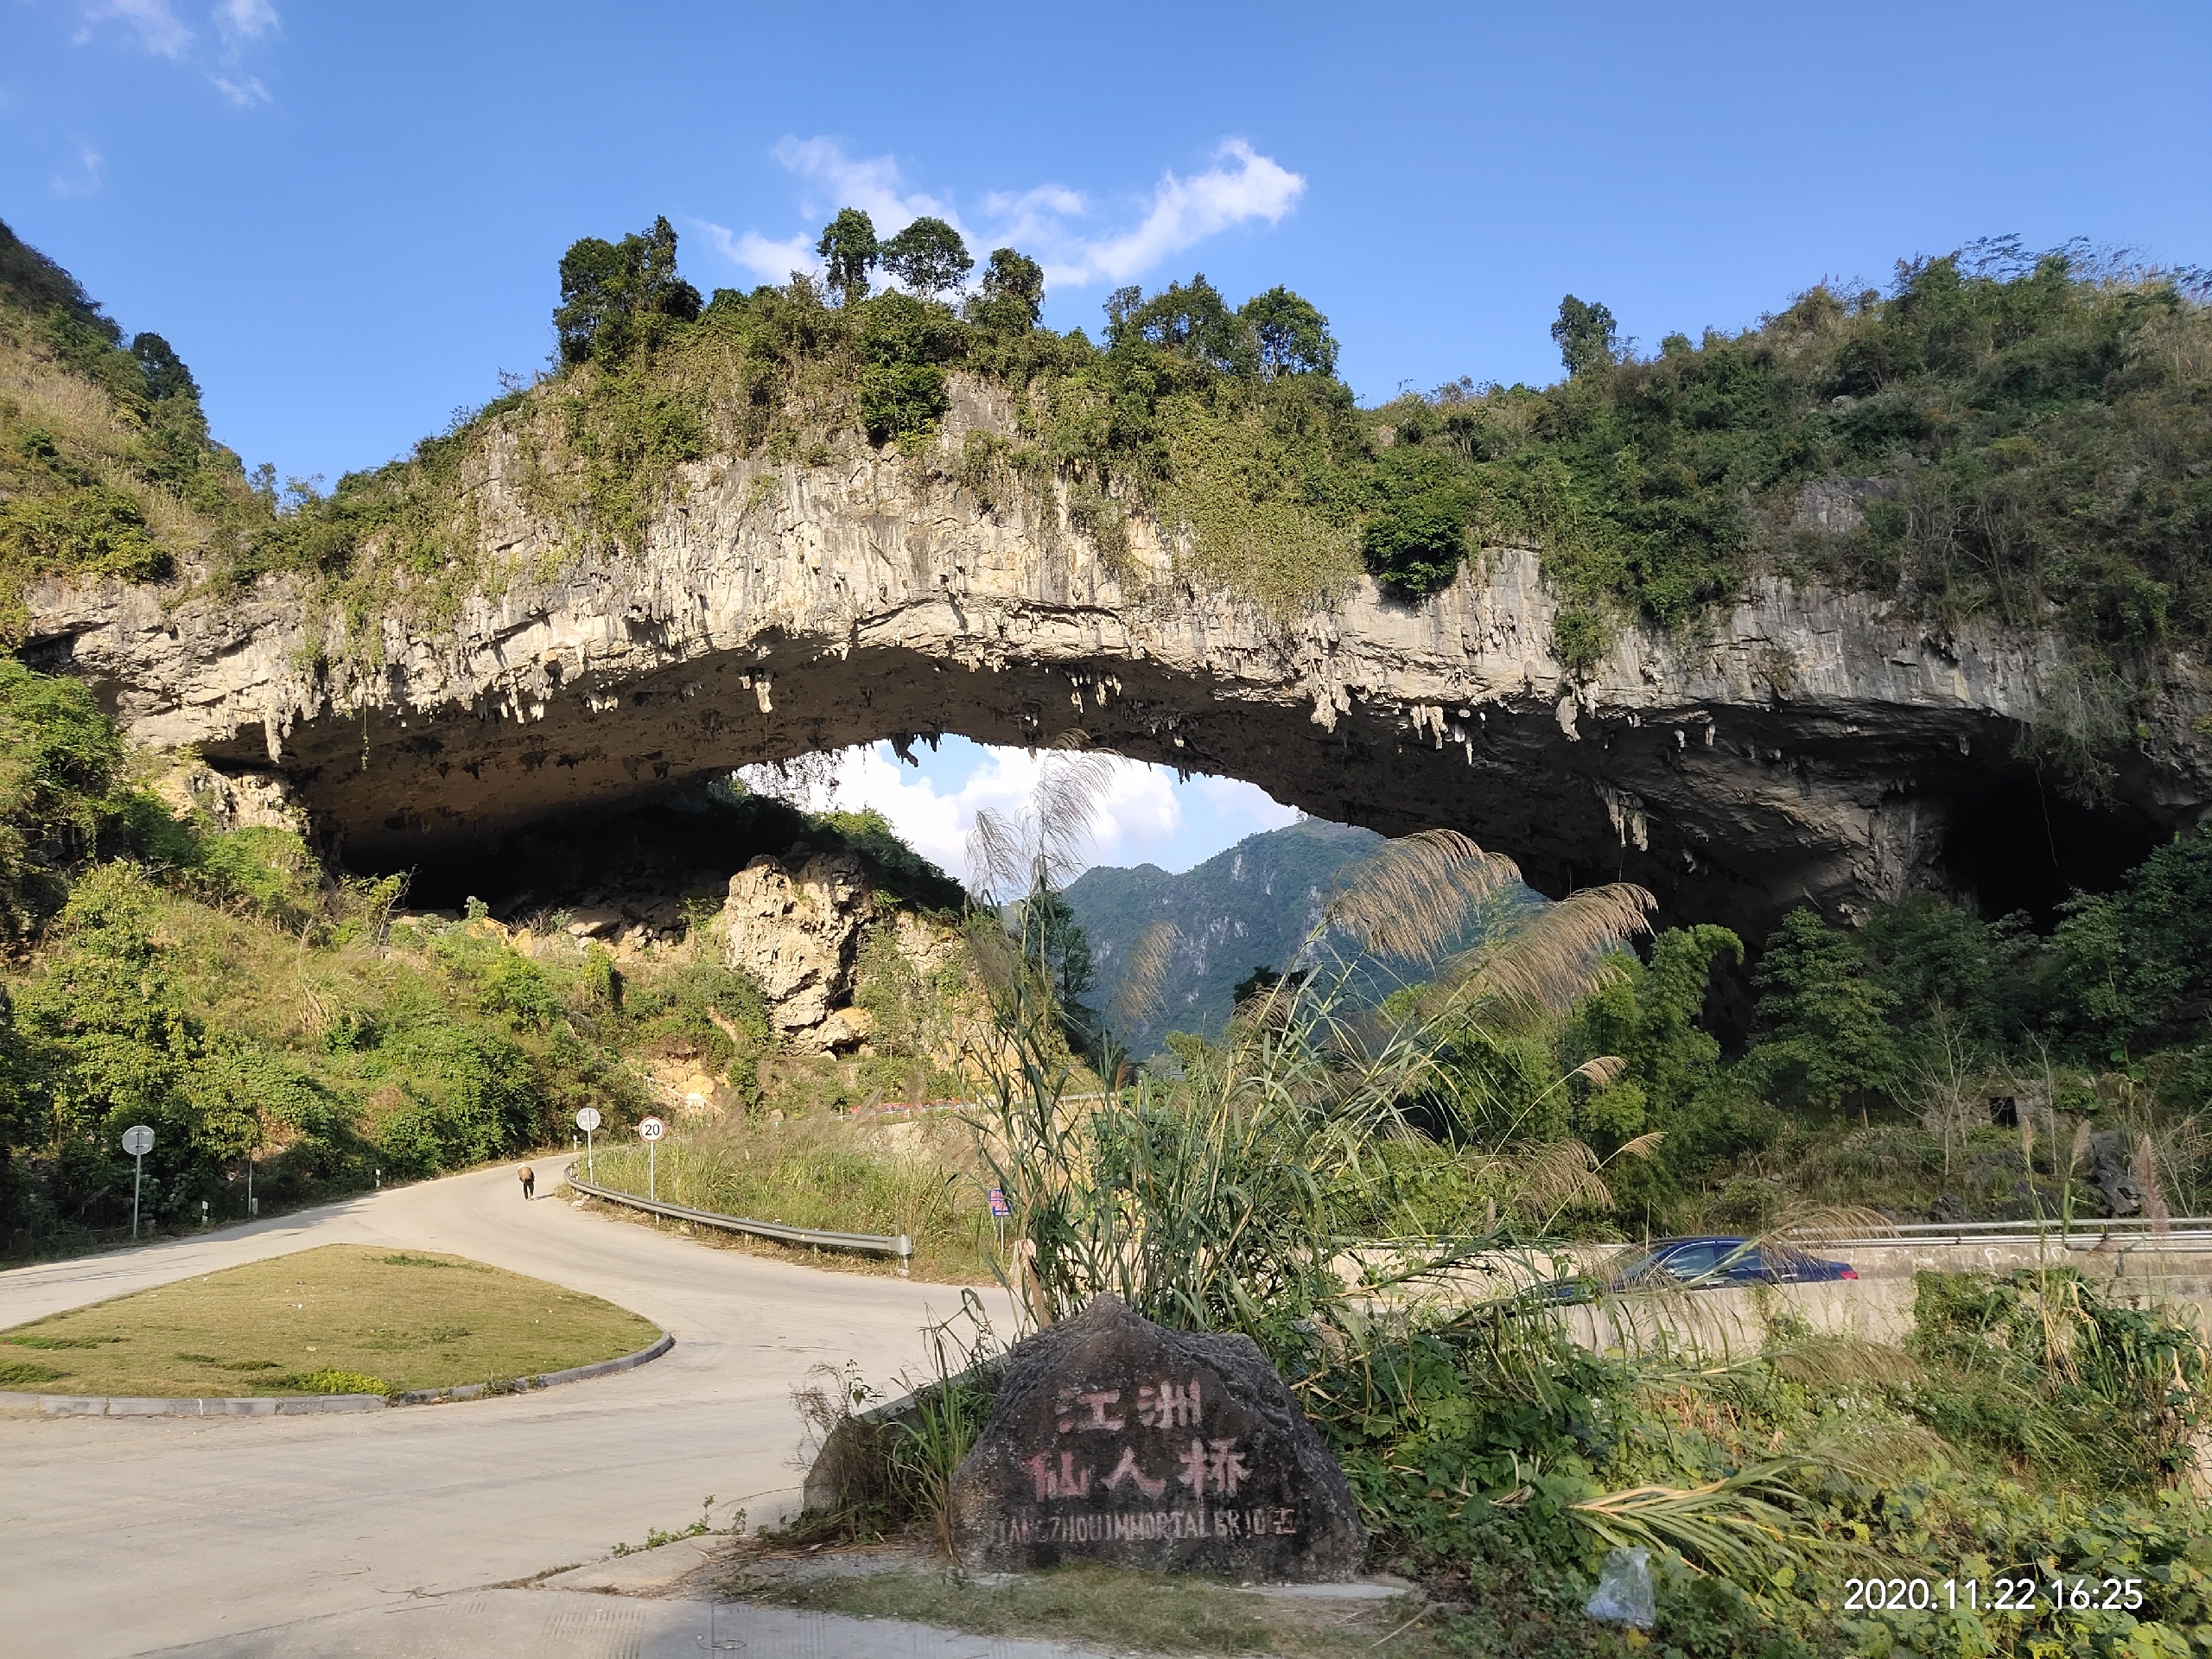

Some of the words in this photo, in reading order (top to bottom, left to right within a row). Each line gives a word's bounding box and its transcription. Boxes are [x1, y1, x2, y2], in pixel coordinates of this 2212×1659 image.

[645, 1124, 660, 1136] 20
[1054, 1379, 1203, 1434] 江洲
[1020, 1437, 1254, 1503] 仙人桥
